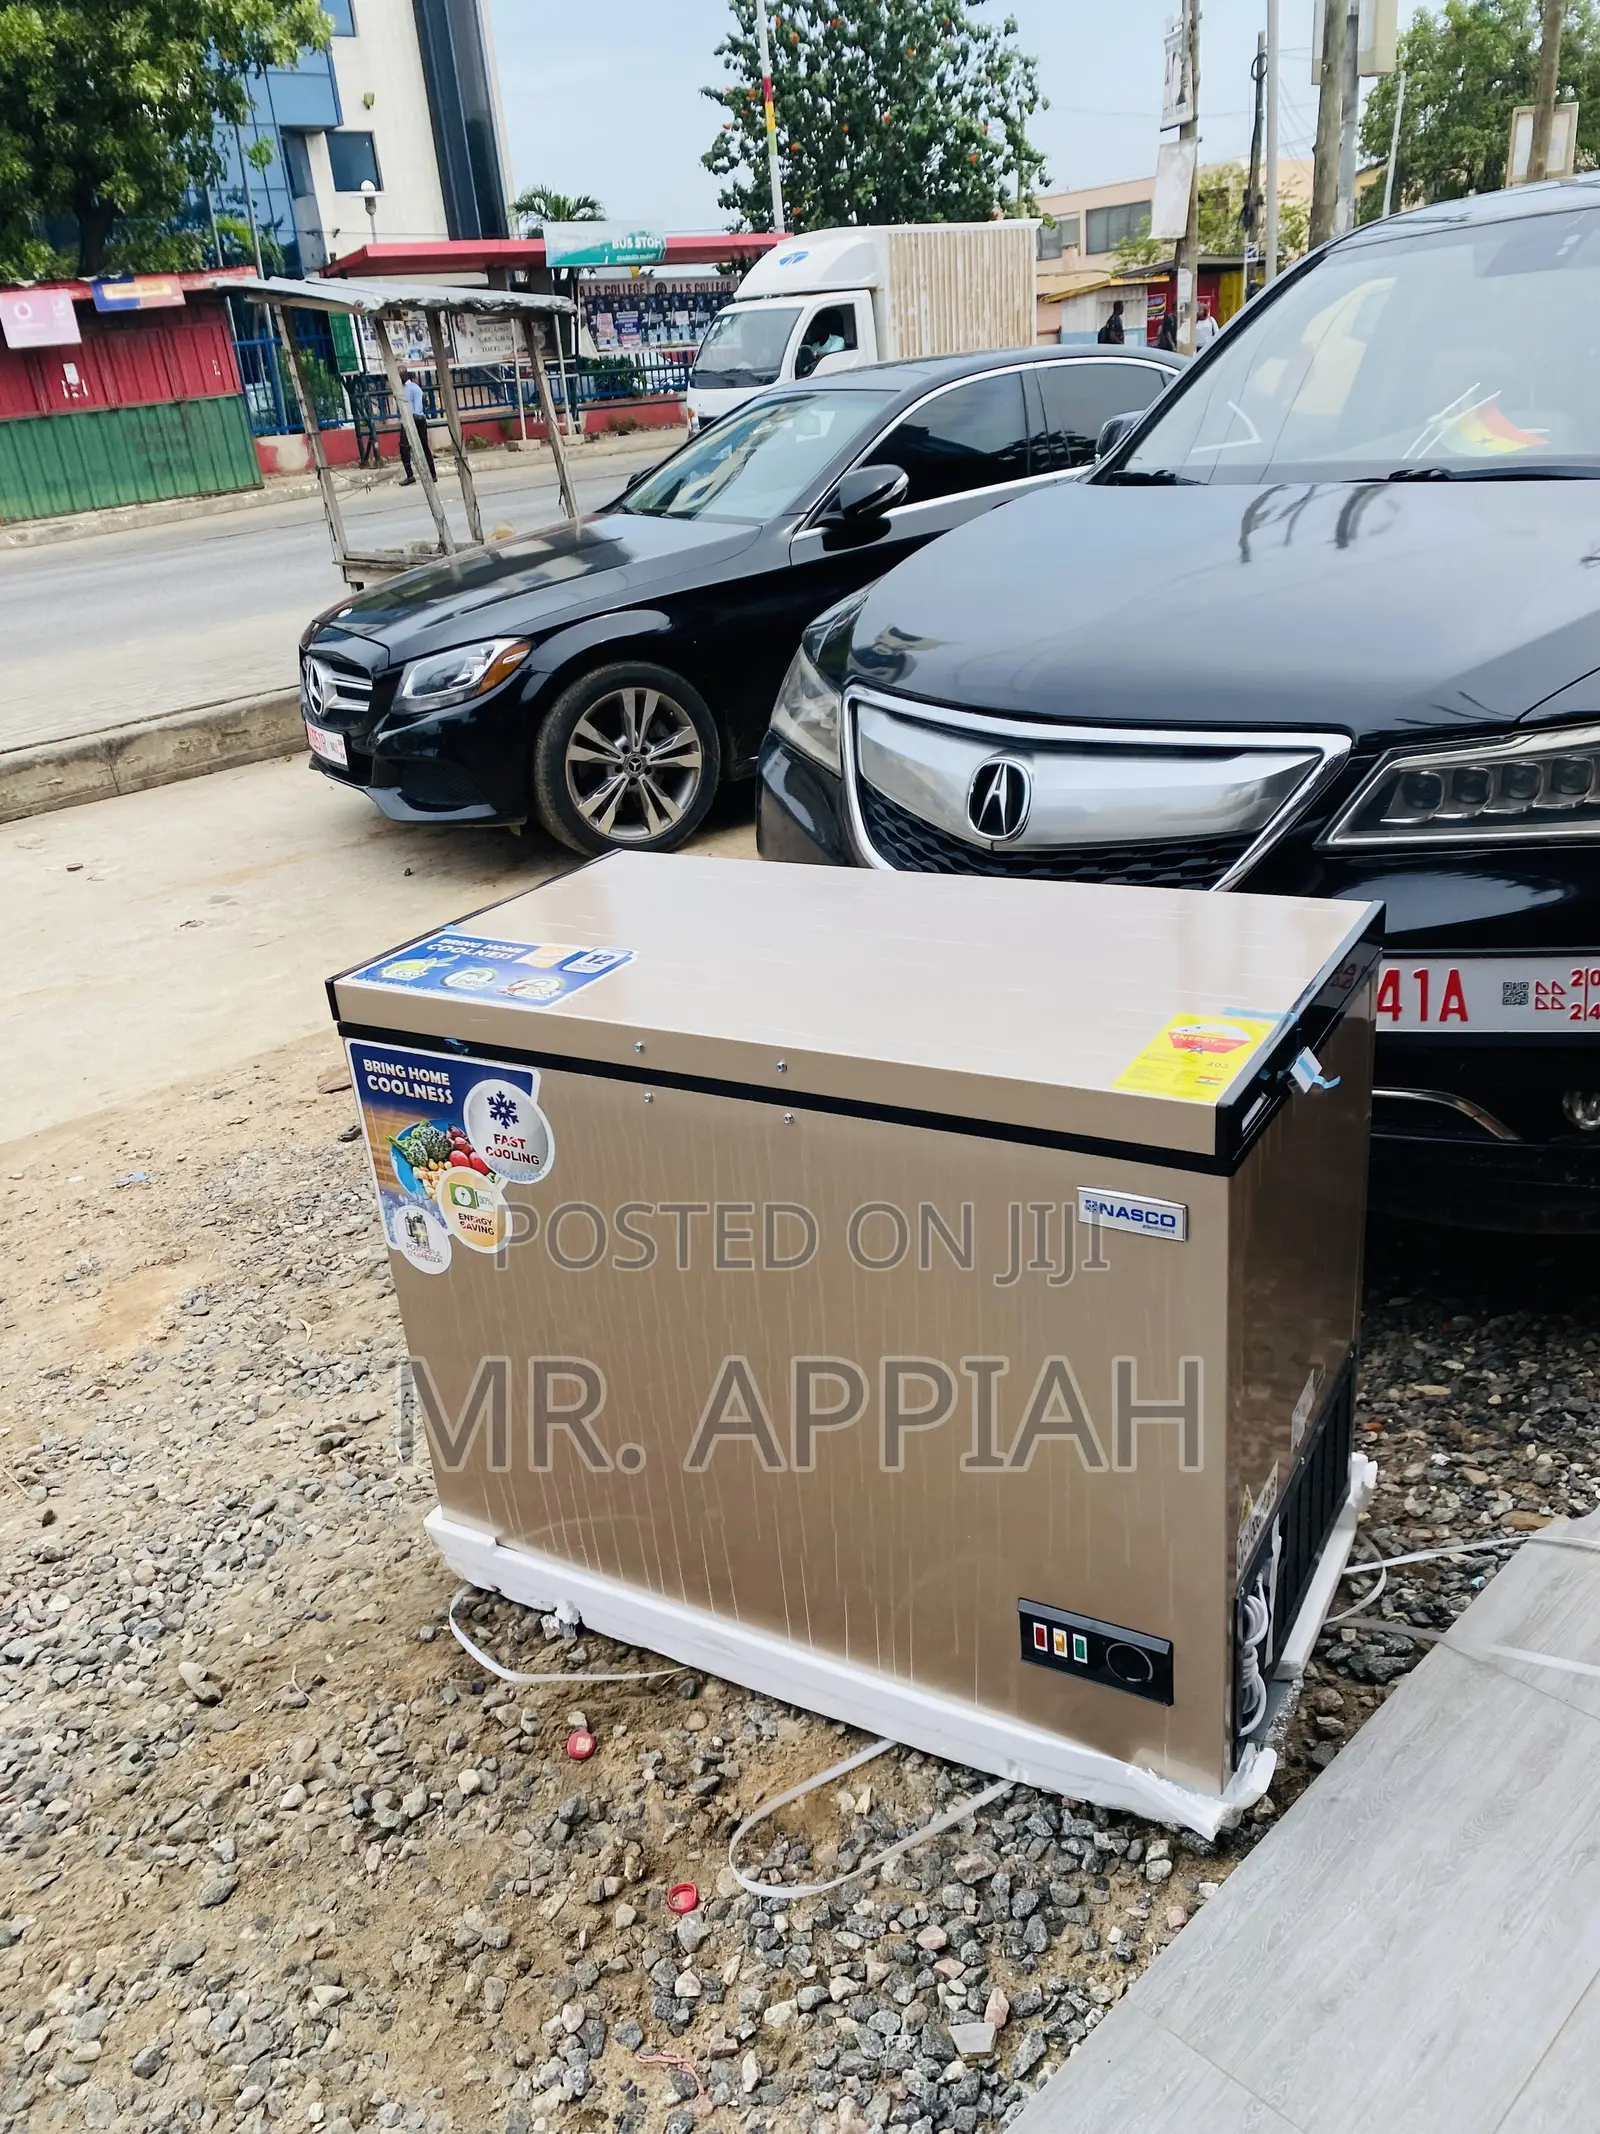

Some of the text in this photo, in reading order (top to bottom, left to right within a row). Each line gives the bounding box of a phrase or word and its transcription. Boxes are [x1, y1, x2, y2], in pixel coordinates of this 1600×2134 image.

[612, 236, 661, 249] BUS STOP
[604, 282, 645, 296] COLLEGE
[426, 943, 516, 960] COOLNESS
[438, 938, 527, 953] BRING HOME
[585, 954, 615, 965] 12
[1172, 1034, 1218, 1045] ENERGY
[363, 1058, 451, 1086] BRING HOME
[366, 1075, 454, 1105] COOLNESS
[493, 1133, 527, 1150] FAST
[485, 1146, 540, 1166] COOLING
[458, 1212, 493, 1227] ENERGY
[1099, 1202, 1176, 1228] NASCO
[459, 1221, 495, 1236] SAVING
